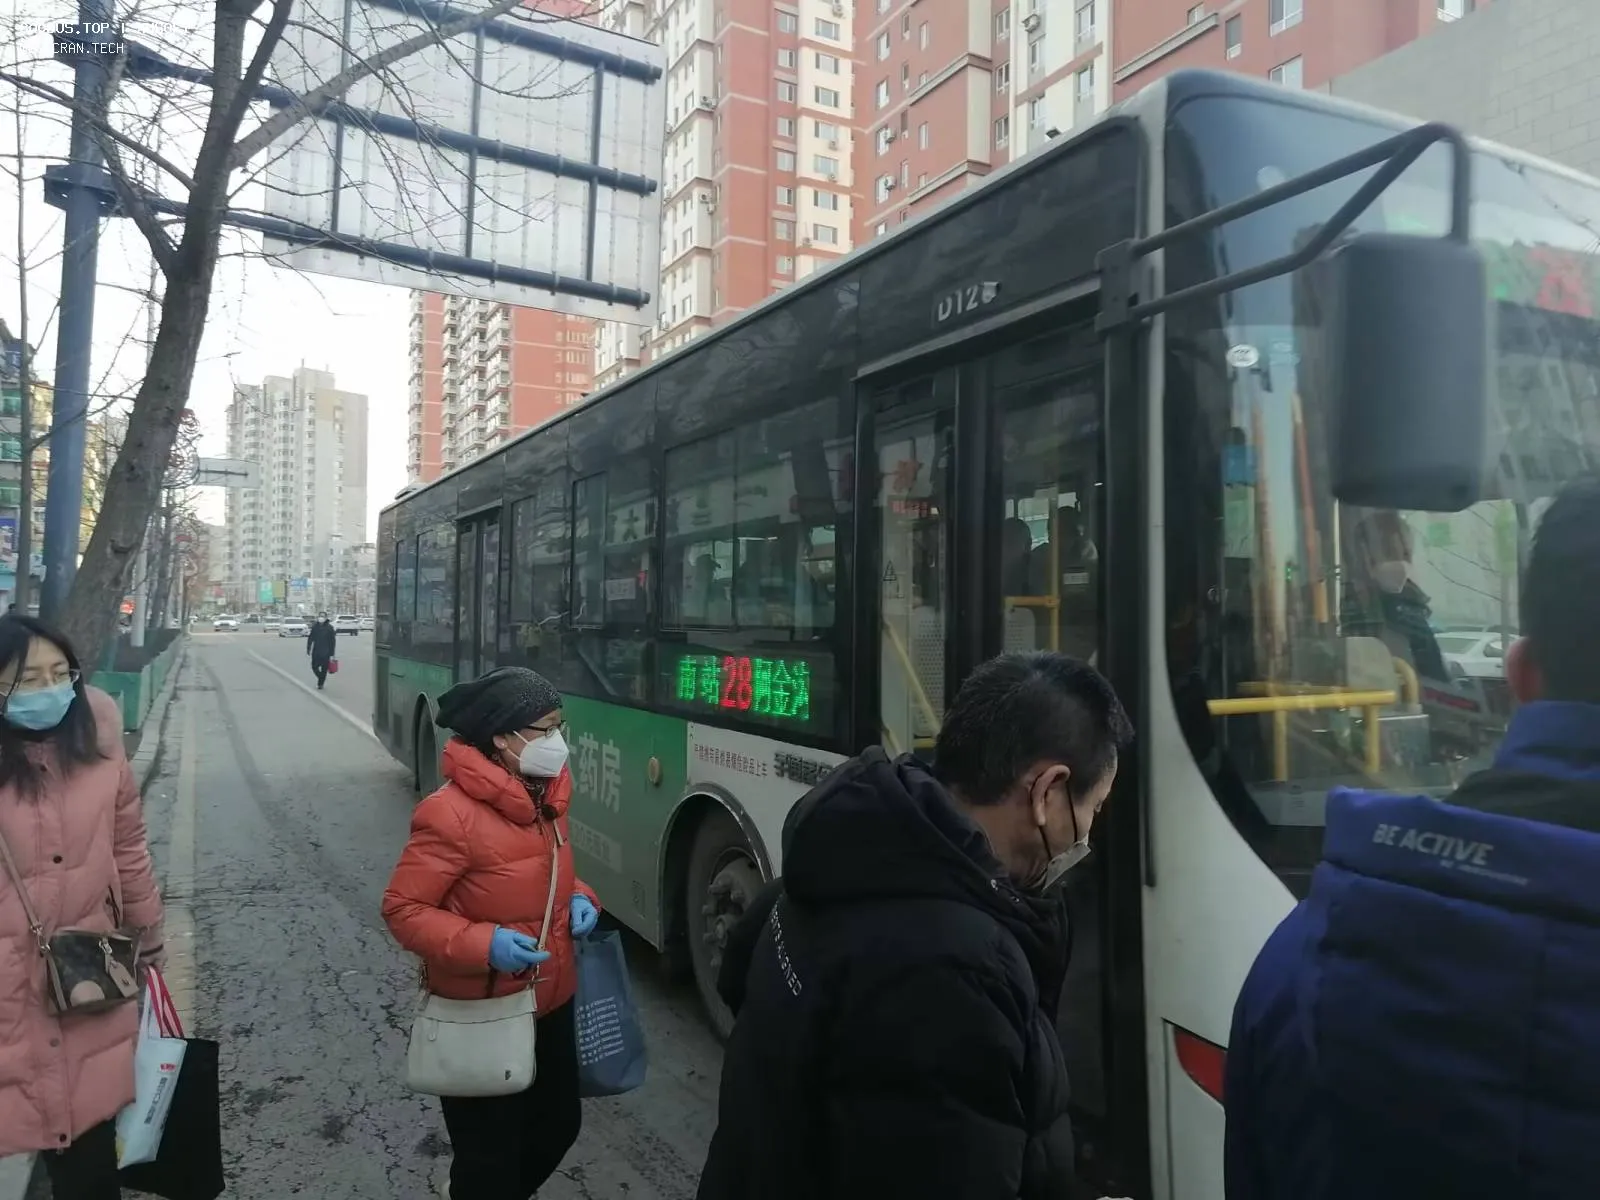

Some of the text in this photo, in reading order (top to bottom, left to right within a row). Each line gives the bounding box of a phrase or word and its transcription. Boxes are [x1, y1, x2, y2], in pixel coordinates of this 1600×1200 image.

[938, 281, 999, 321] D12
[1372, 823, 1494, 866] BE ACTIVE
